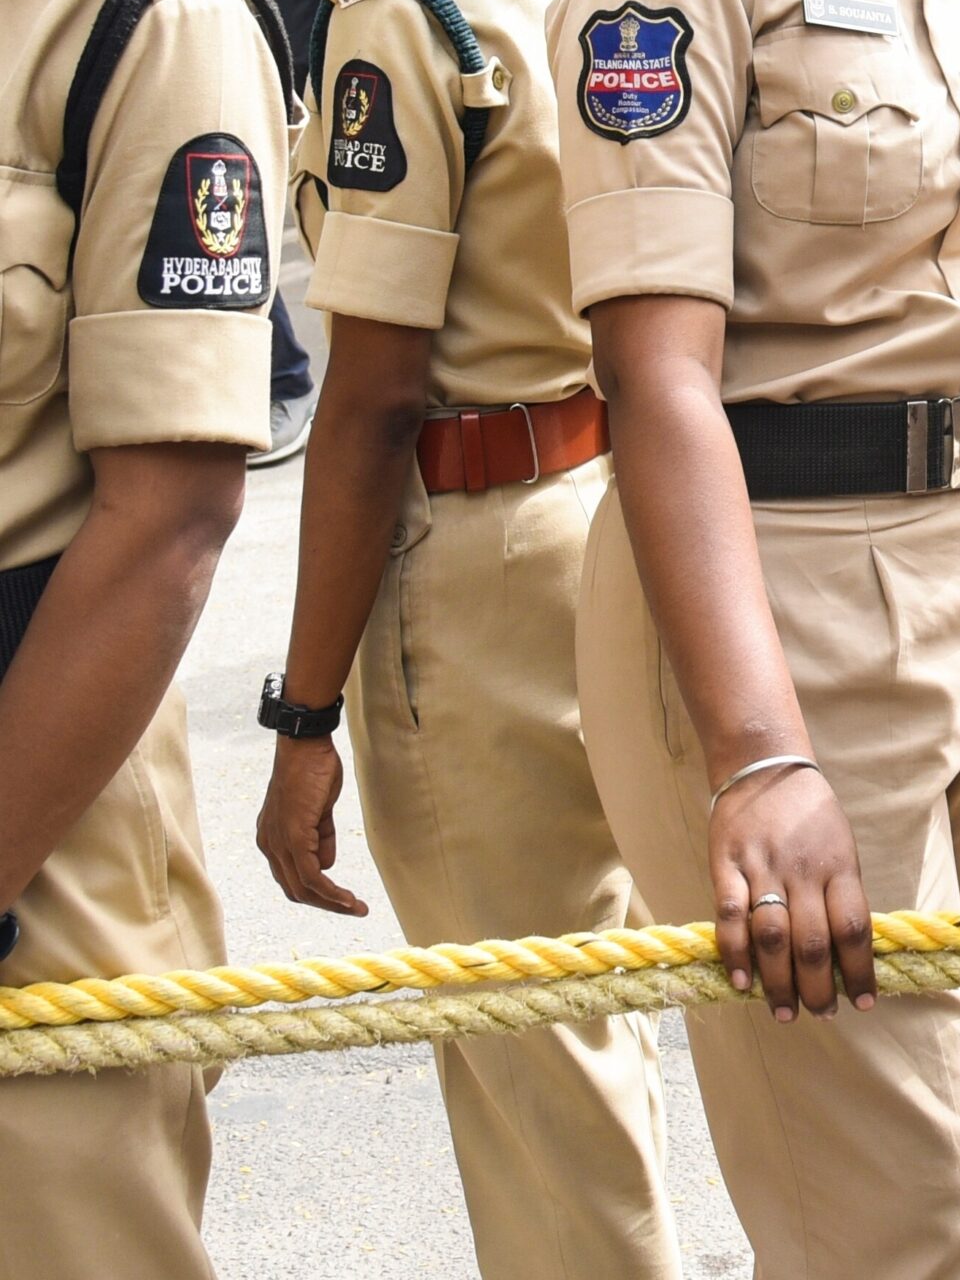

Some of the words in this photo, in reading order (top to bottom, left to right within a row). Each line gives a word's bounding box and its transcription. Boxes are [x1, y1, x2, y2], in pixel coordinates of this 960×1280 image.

[594, 58, 641, 70] TELANGANA
[643, 56, 671, 70] STATE
[590, 71, 675, 89] POLICE
[622, 92, 638, 101] Duty
[363, 142, 387, 156] CITY
[162, 257, 240, 276] HYDERABAD
[241, 257, 262, 275] CITY
[160, 273, 262, 295] POLICE
